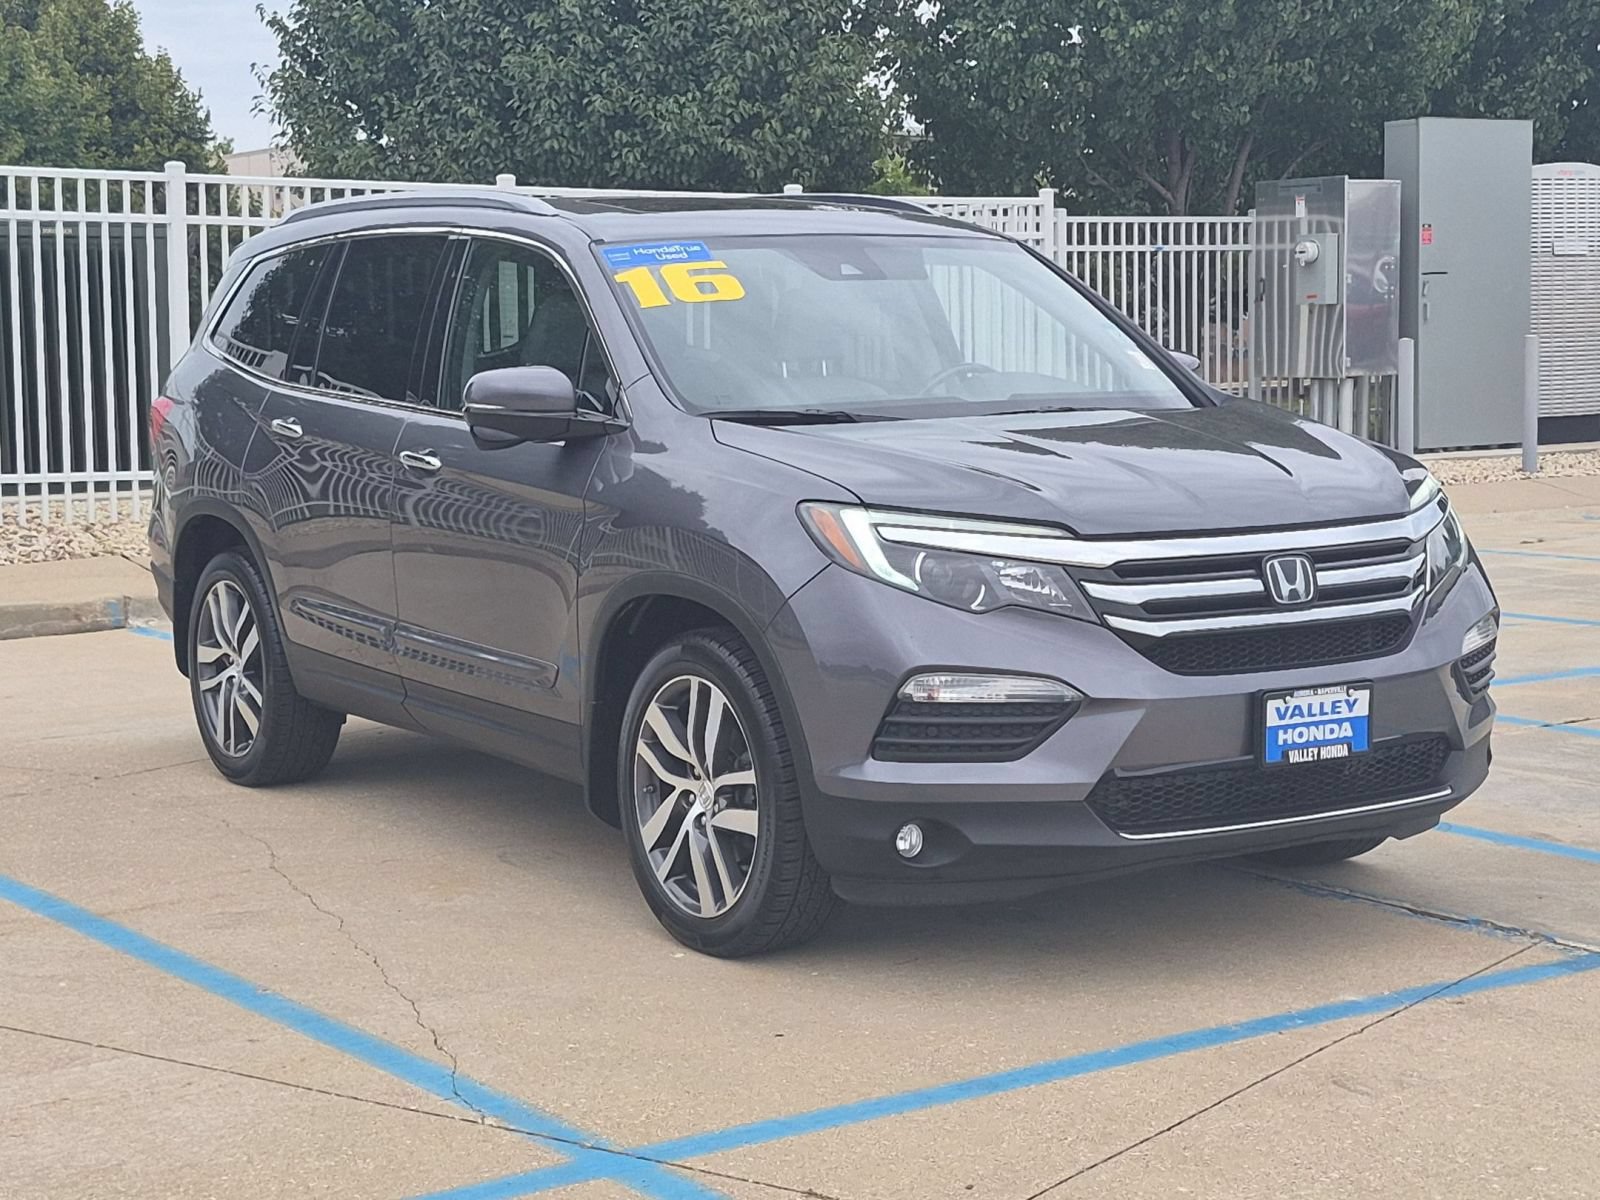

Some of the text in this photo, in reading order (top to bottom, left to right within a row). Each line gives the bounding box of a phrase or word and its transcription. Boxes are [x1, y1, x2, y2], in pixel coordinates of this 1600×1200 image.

[633, 244, 702, 256] HondaTrue
[656, 252, 689, 261] Used
[614, 260, 746, 309] 16
[1275, 698, 1359, 721] VALLEY
[1278, 722, 1353, 746] HONDA
[1288, 744, 1349, 764] VALLEY HONDA
